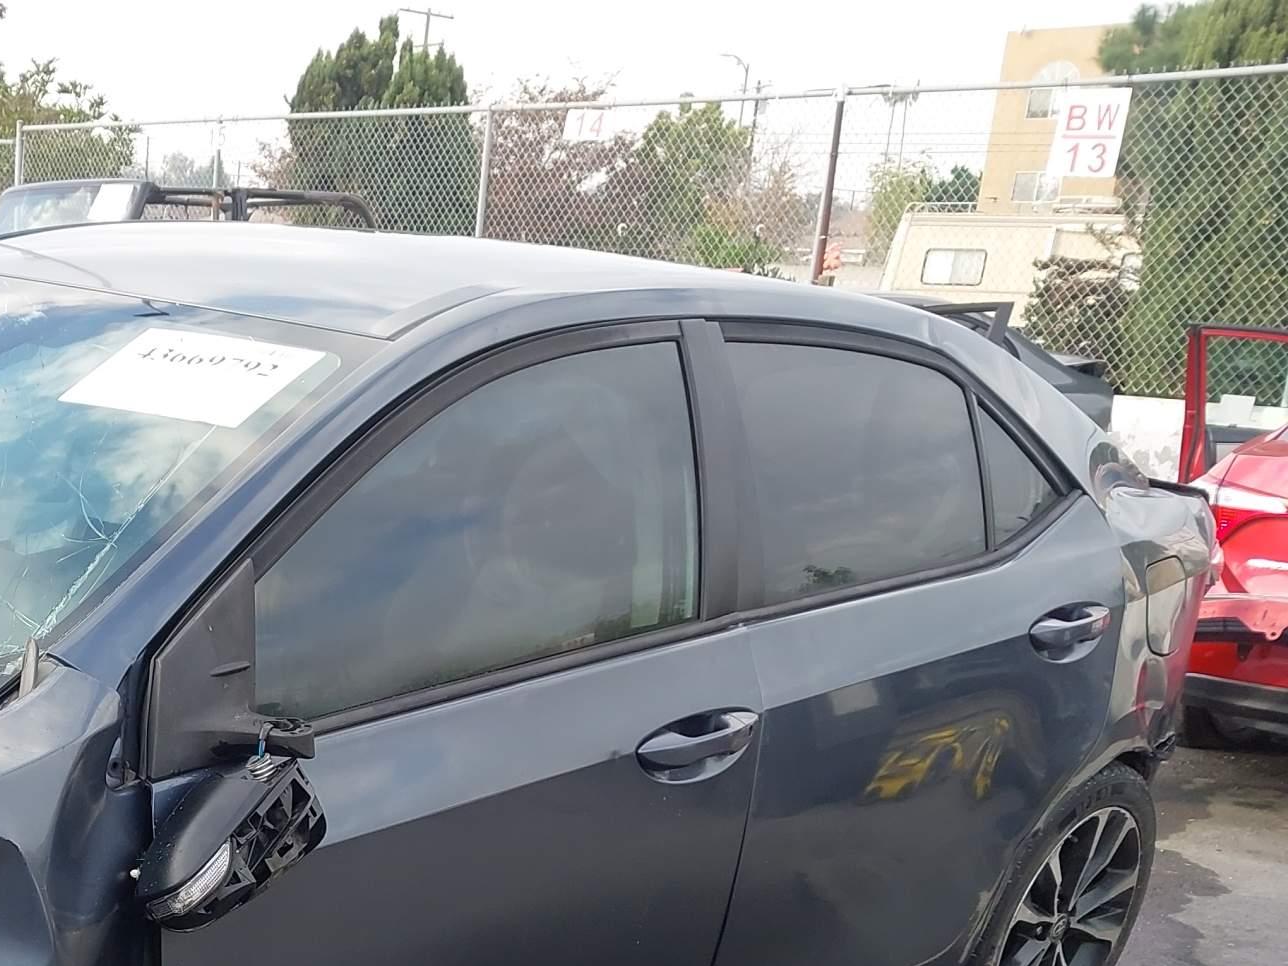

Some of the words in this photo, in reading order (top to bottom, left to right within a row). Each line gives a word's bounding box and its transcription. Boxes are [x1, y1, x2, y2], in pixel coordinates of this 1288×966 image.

[576, 112, 604, 137] 14
[1065, 104, 1121, 131] BW
[1067, 143, 1107, 173] 13
